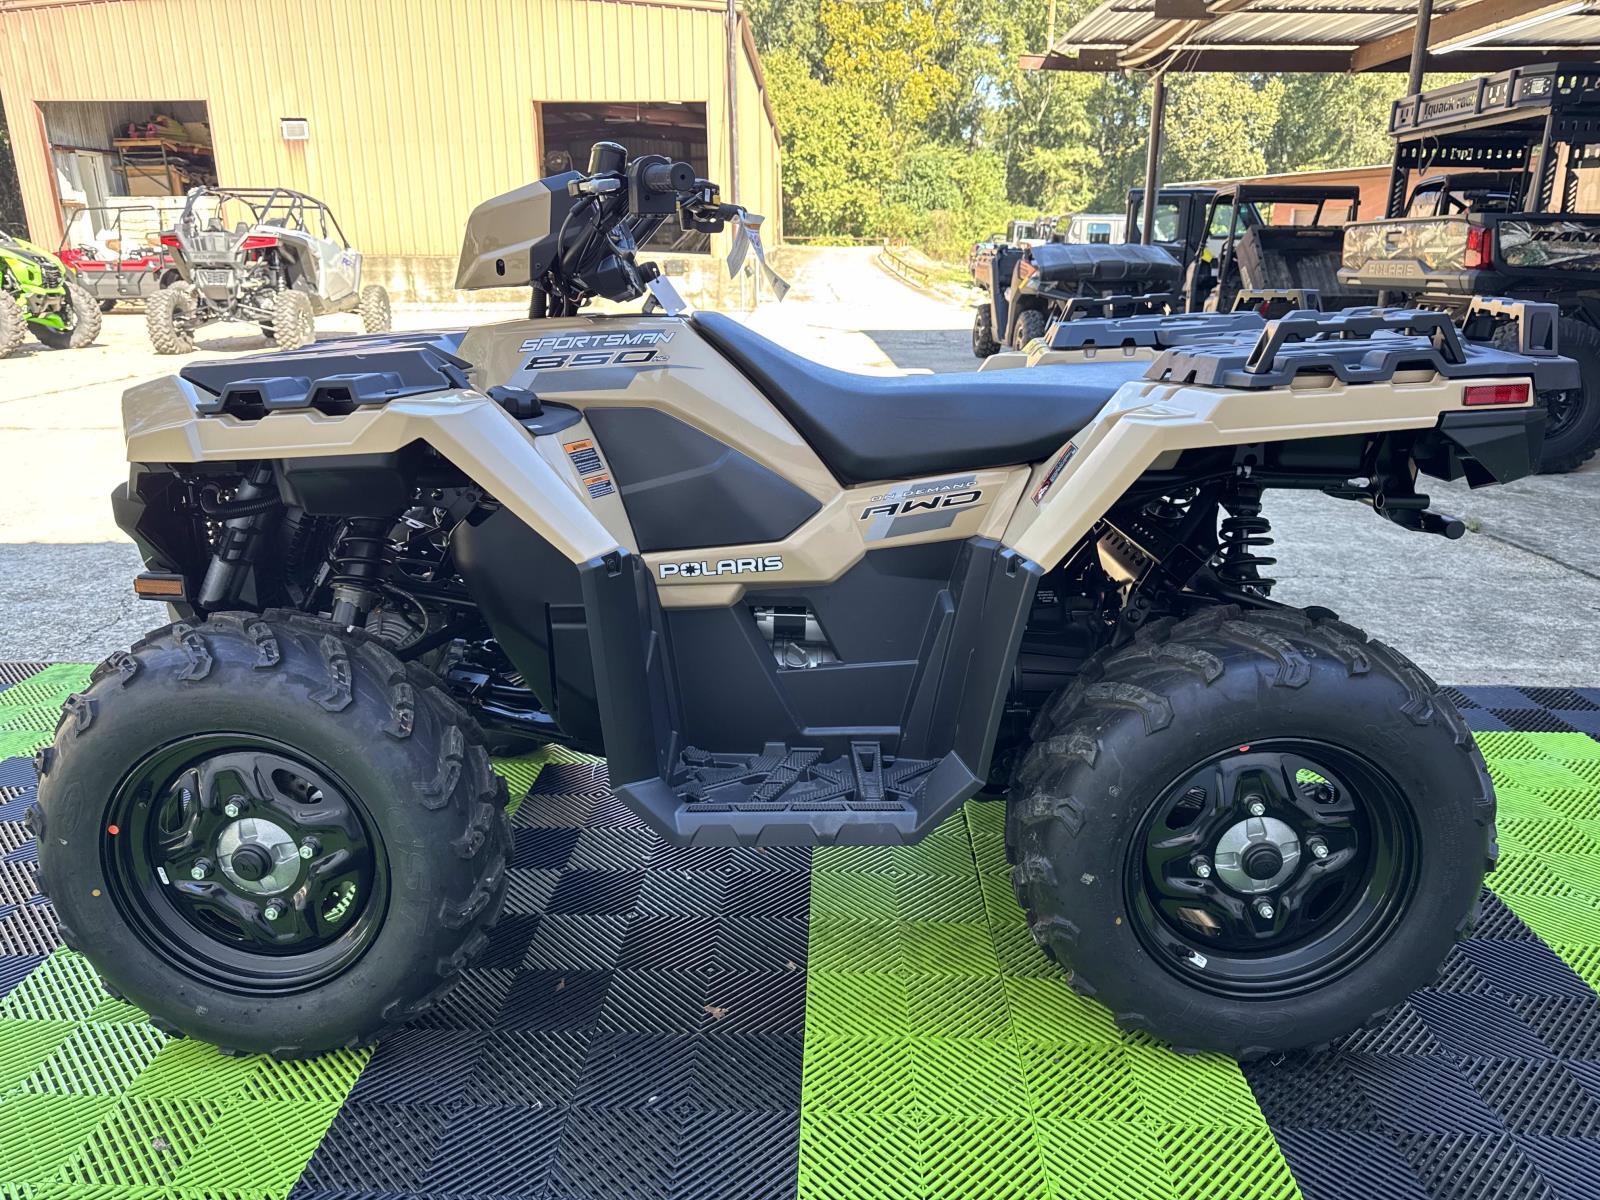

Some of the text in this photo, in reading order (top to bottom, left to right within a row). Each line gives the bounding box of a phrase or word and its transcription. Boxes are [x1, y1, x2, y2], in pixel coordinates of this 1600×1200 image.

[518, 331, 676, 353] SPORTSMAN
[523, 350, 659, 371] 850
[870, 481, 978, 502] ON DEMAND
[859, 490, 983, 521] AWD
[659, 555, 784, 579] POLARIS
